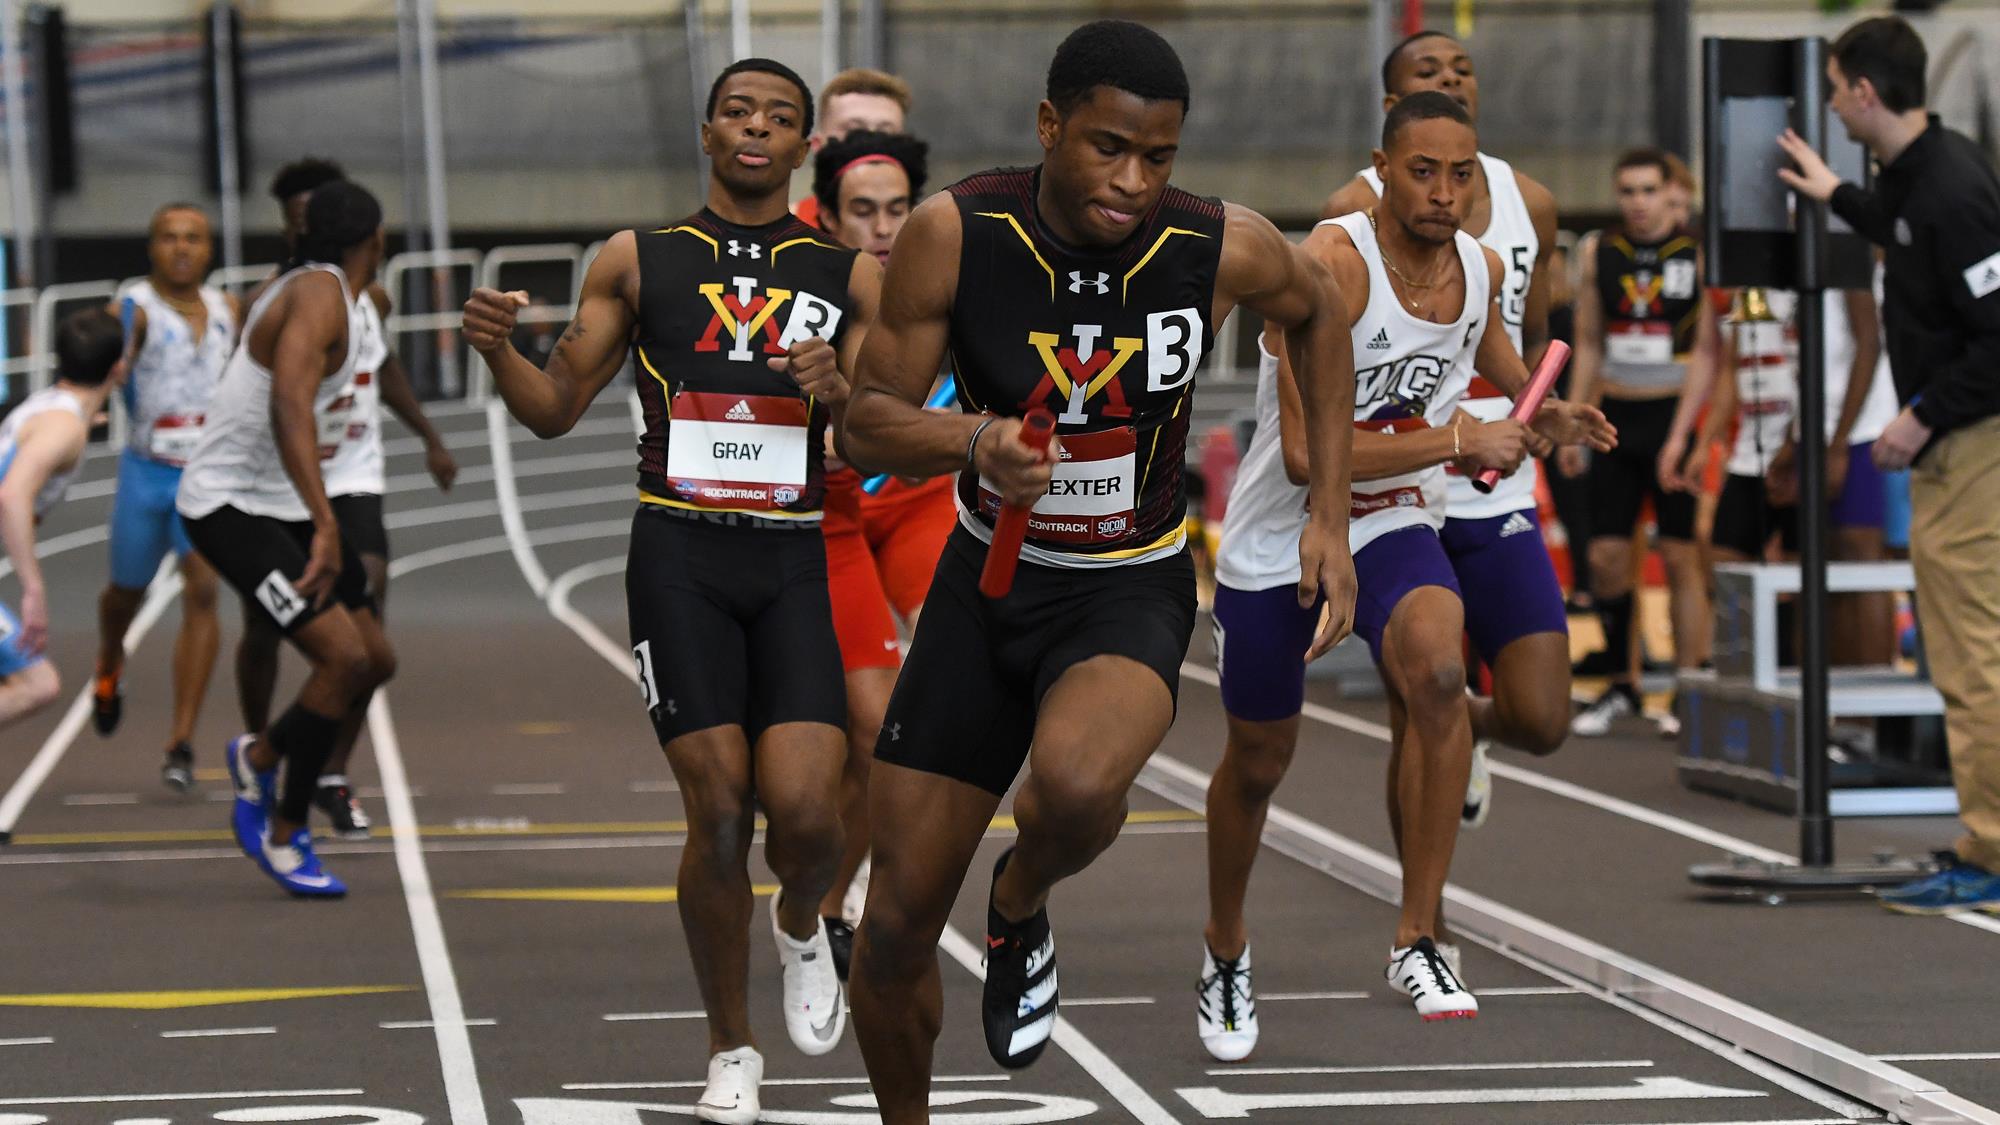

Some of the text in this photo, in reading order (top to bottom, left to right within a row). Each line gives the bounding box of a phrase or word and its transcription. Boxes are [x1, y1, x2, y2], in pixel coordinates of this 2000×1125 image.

[1511, 246, 1529, 295] 5
[791, 300, 829, 344] 3
[1160, 314, 1192, 387] 3
[724, 412, 756, 421] adidas
[713, 441, 763, 461] GRAY
[774, 488, 799, 504] SOCON
[1042, 475, 1121, 497] EXTER
[1098, 516, 1127, 534] SOCON
[267, 581, 294, 612] 4
